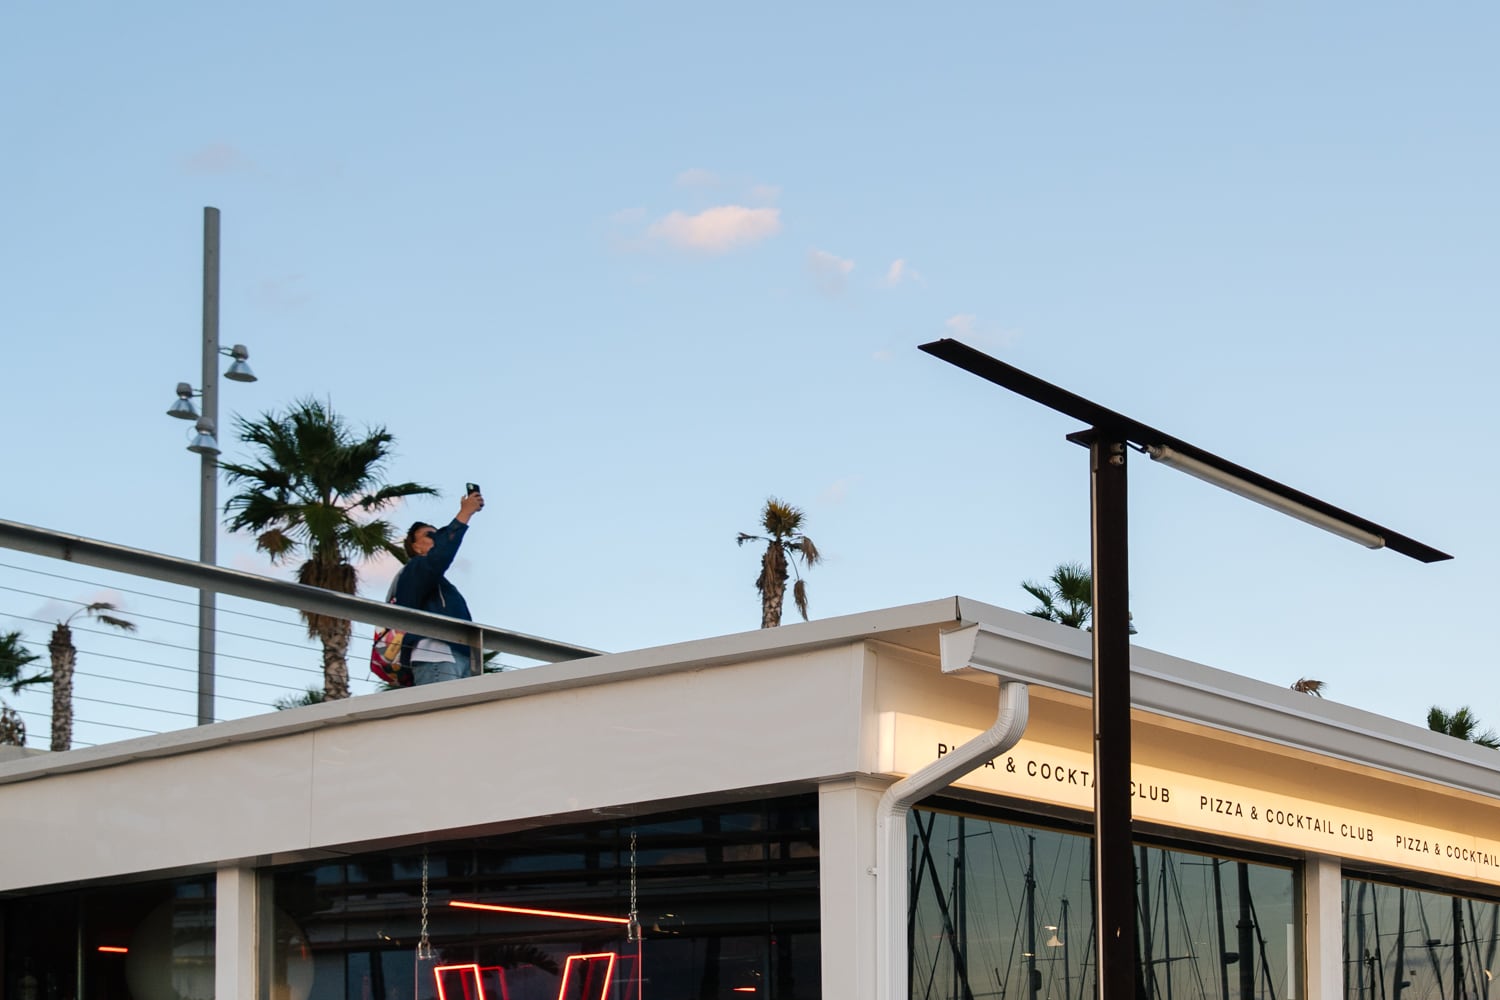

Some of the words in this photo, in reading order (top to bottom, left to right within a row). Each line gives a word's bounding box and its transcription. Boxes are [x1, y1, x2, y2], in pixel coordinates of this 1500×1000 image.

[1006, 757, 1016, 773] &
[1027, 761, 1095, 788] COCKT
[1130, 781, 1170, 803] CLUB
[1200, 796, 1243, 817] PIZZA
[1250, 806, 1258, 820] &
[1266, 809, 1334, 834] COCKTAIL
[1340, 824, 1373, 841] CLUB
[1396, 835, 1429, 853] PIZZA
[1434, 843, 1441, 855] &
[1446, 845, 1499, 867] COCKTAIL
